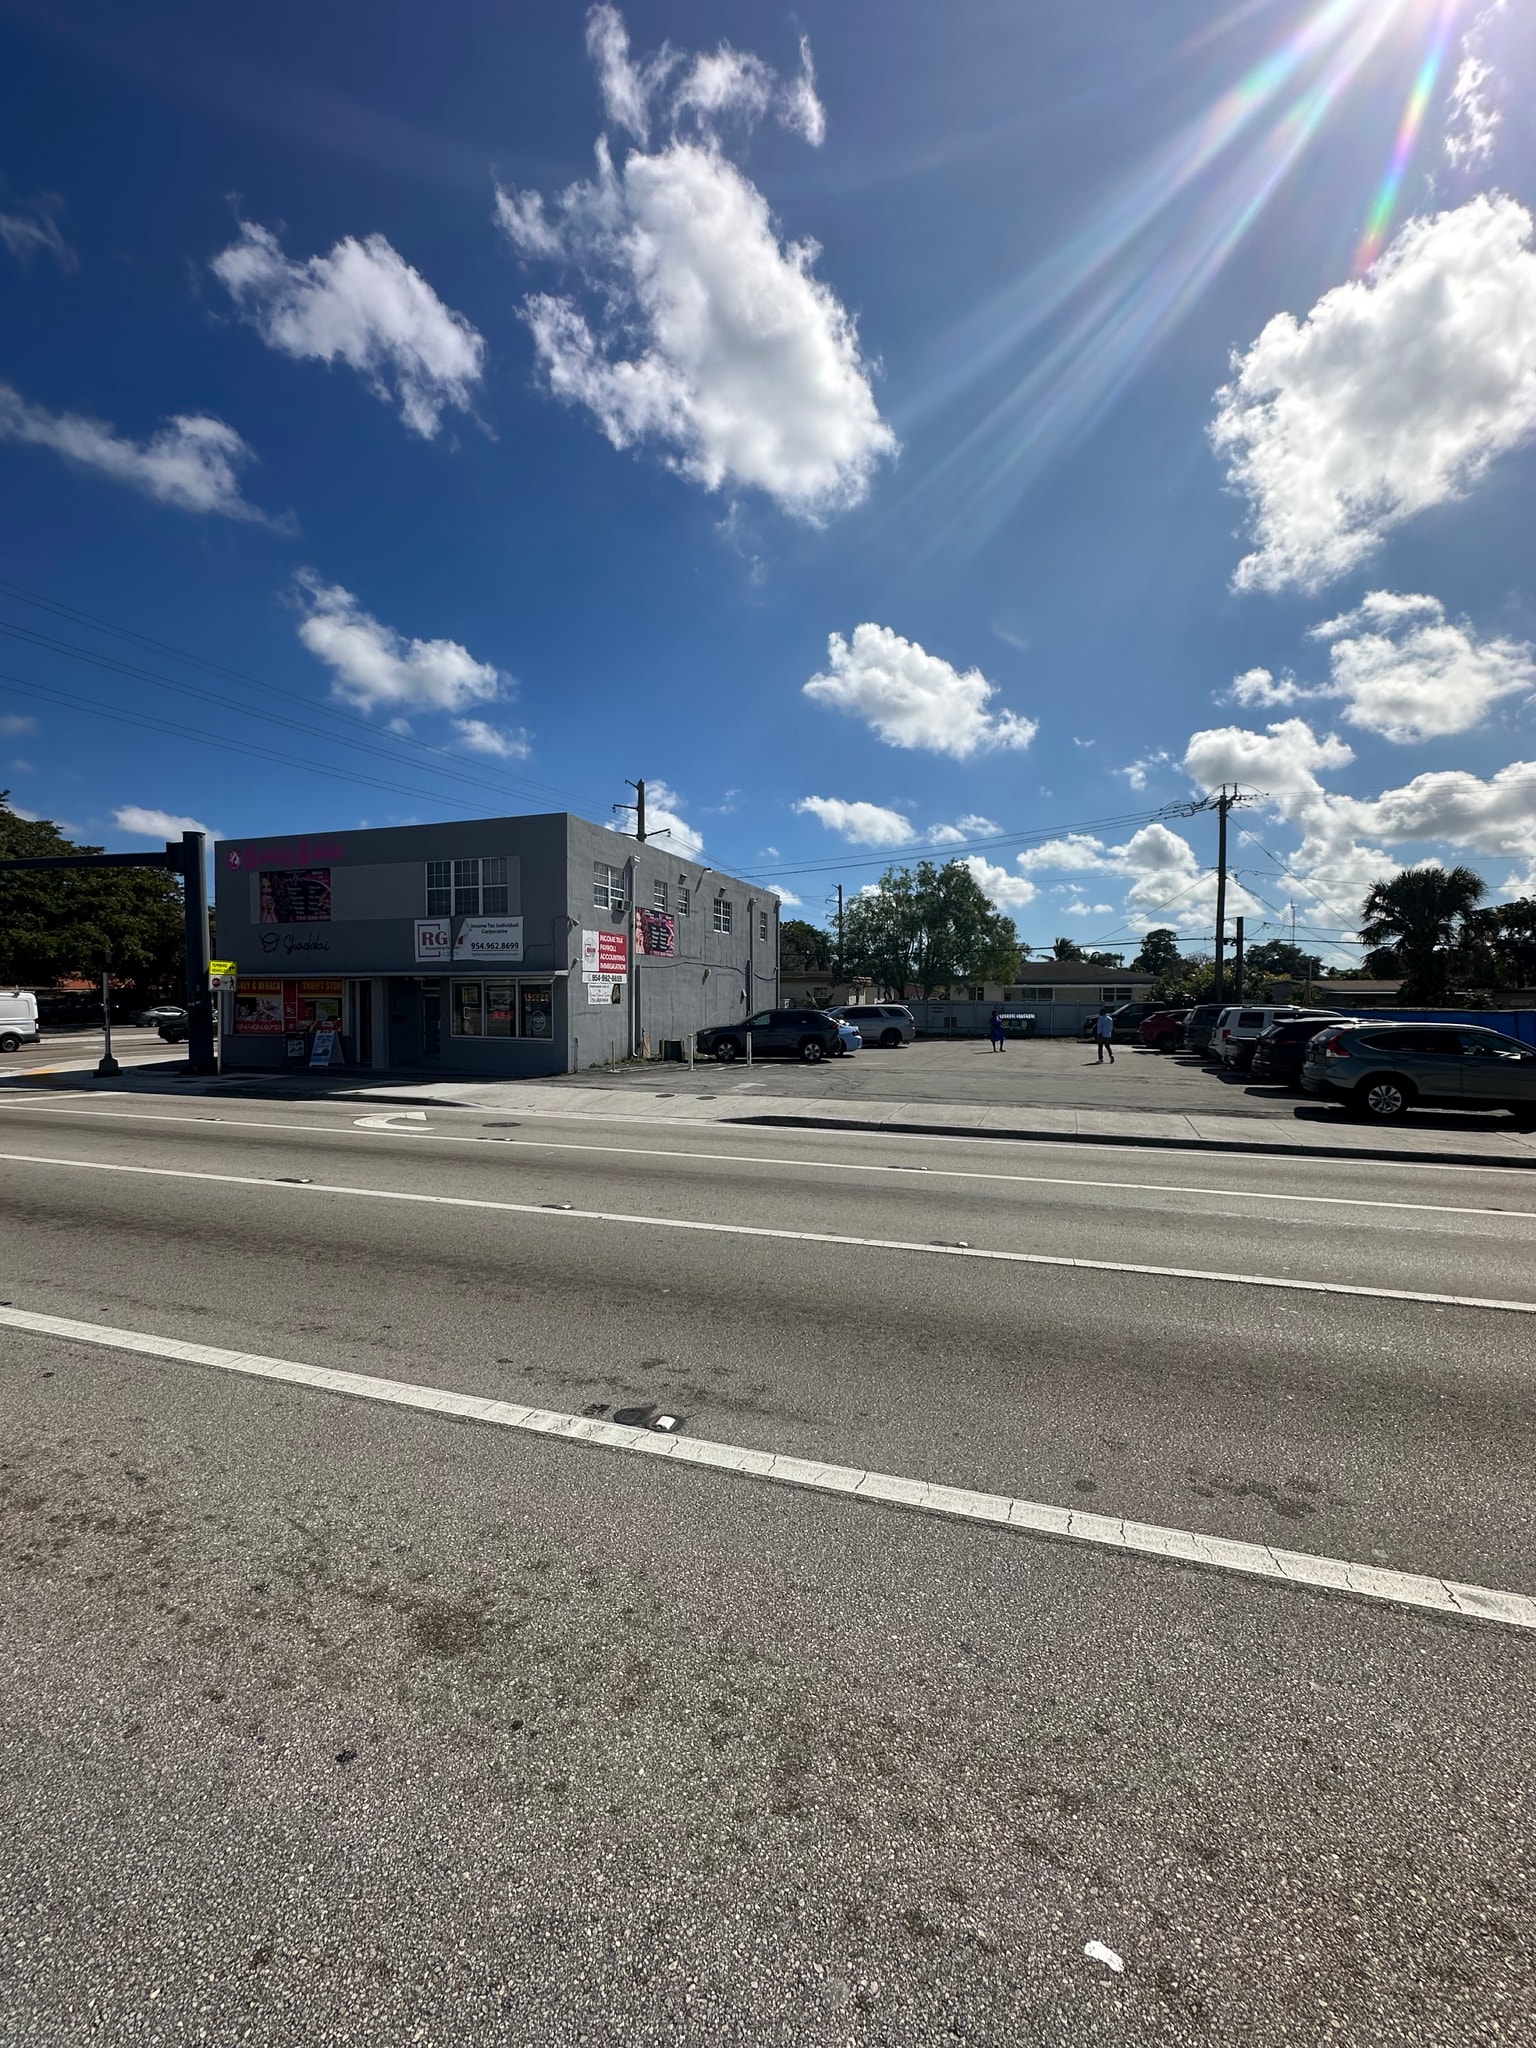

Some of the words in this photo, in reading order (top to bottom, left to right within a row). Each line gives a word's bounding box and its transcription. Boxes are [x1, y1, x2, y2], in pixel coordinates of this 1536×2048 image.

[600, 935, 615, 943] INCOME
[259, 933, 280, 953] El
[283, 931, 330, 956] Shaddai
[471, 942, 519, 950] 954.962.8699
[600, 944, 617, 952] PAYROLL
[600, 953, 626, 962] ACCOUNTING
[600, 962, 627, 970] IMMIGRATION
[302, 981, 324, 991] THRIFT
